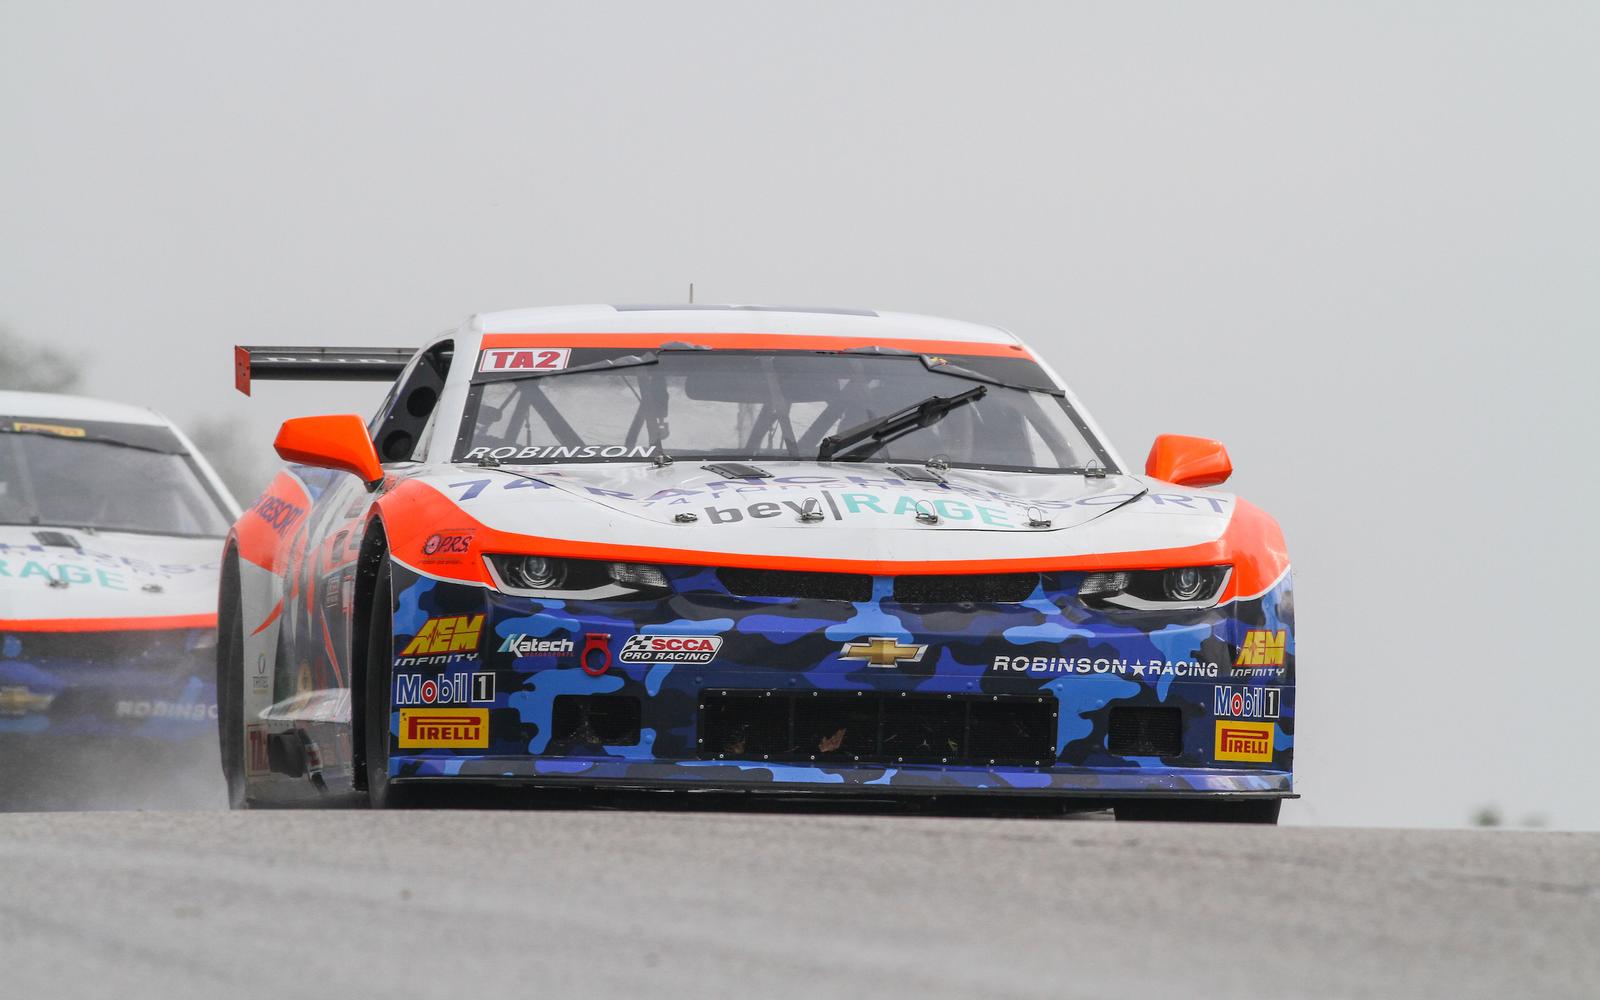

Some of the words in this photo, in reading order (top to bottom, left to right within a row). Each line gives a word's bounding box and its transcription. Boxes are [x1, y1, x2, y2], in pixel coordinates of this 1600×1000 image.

[491, 351, 561, 369] TA2
[464, 446, 656, 459] ROBINSON
[448, 478, 556, 501] 74
[402, 615, 485, 654] AEM
[506, 634, 574, 657] Katech
[651, 638, 715, 651] SCCA
[394, 652, 480, 666] INFINITY
[622, 652, 651, 661] PRO
[654, 652, 712, 662] RACING
[1234, 630, 1287, 666] AEM
[992, 655, 1127, 674] ROBINSON
[1148, 659, 1219, 678] RACING
[1230, 668, 1286, 677] INFINITY
[396, 672, 468, 704] Mobil
[1214, 685, 1263, 718] Mobil
[407, 716, 482, 741] PIRELLI
[1220, 728, 1270, 755] PIRELLI
